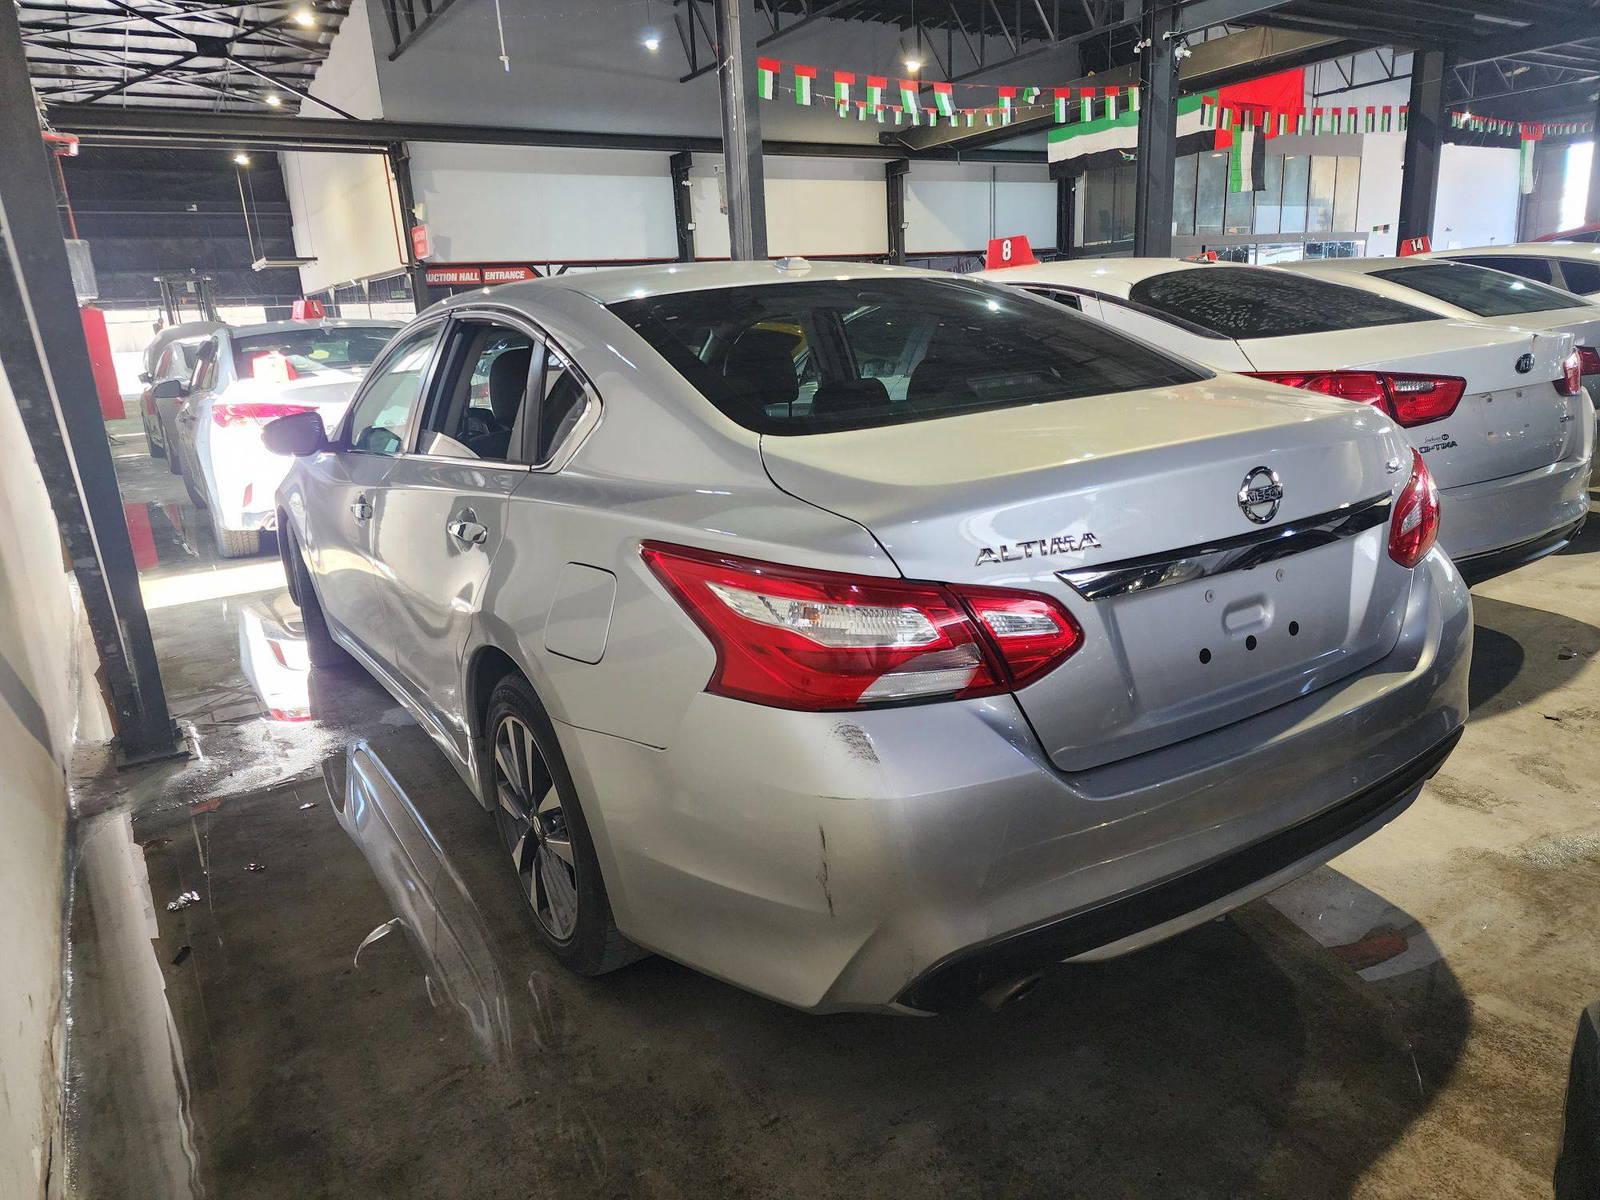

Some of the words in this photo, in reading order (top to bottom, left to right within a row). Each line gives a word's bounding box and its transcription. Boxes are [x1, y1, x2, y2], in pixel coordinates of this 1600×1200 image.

[1002, 239, 1012, 261] 8
[1411, 239, 1423, 252] 14
[460, 271, 480, 281] HALL
[484, 270, 526, 280] ENTRANCE
[975, 532, 1102, 567] ALTIMA
